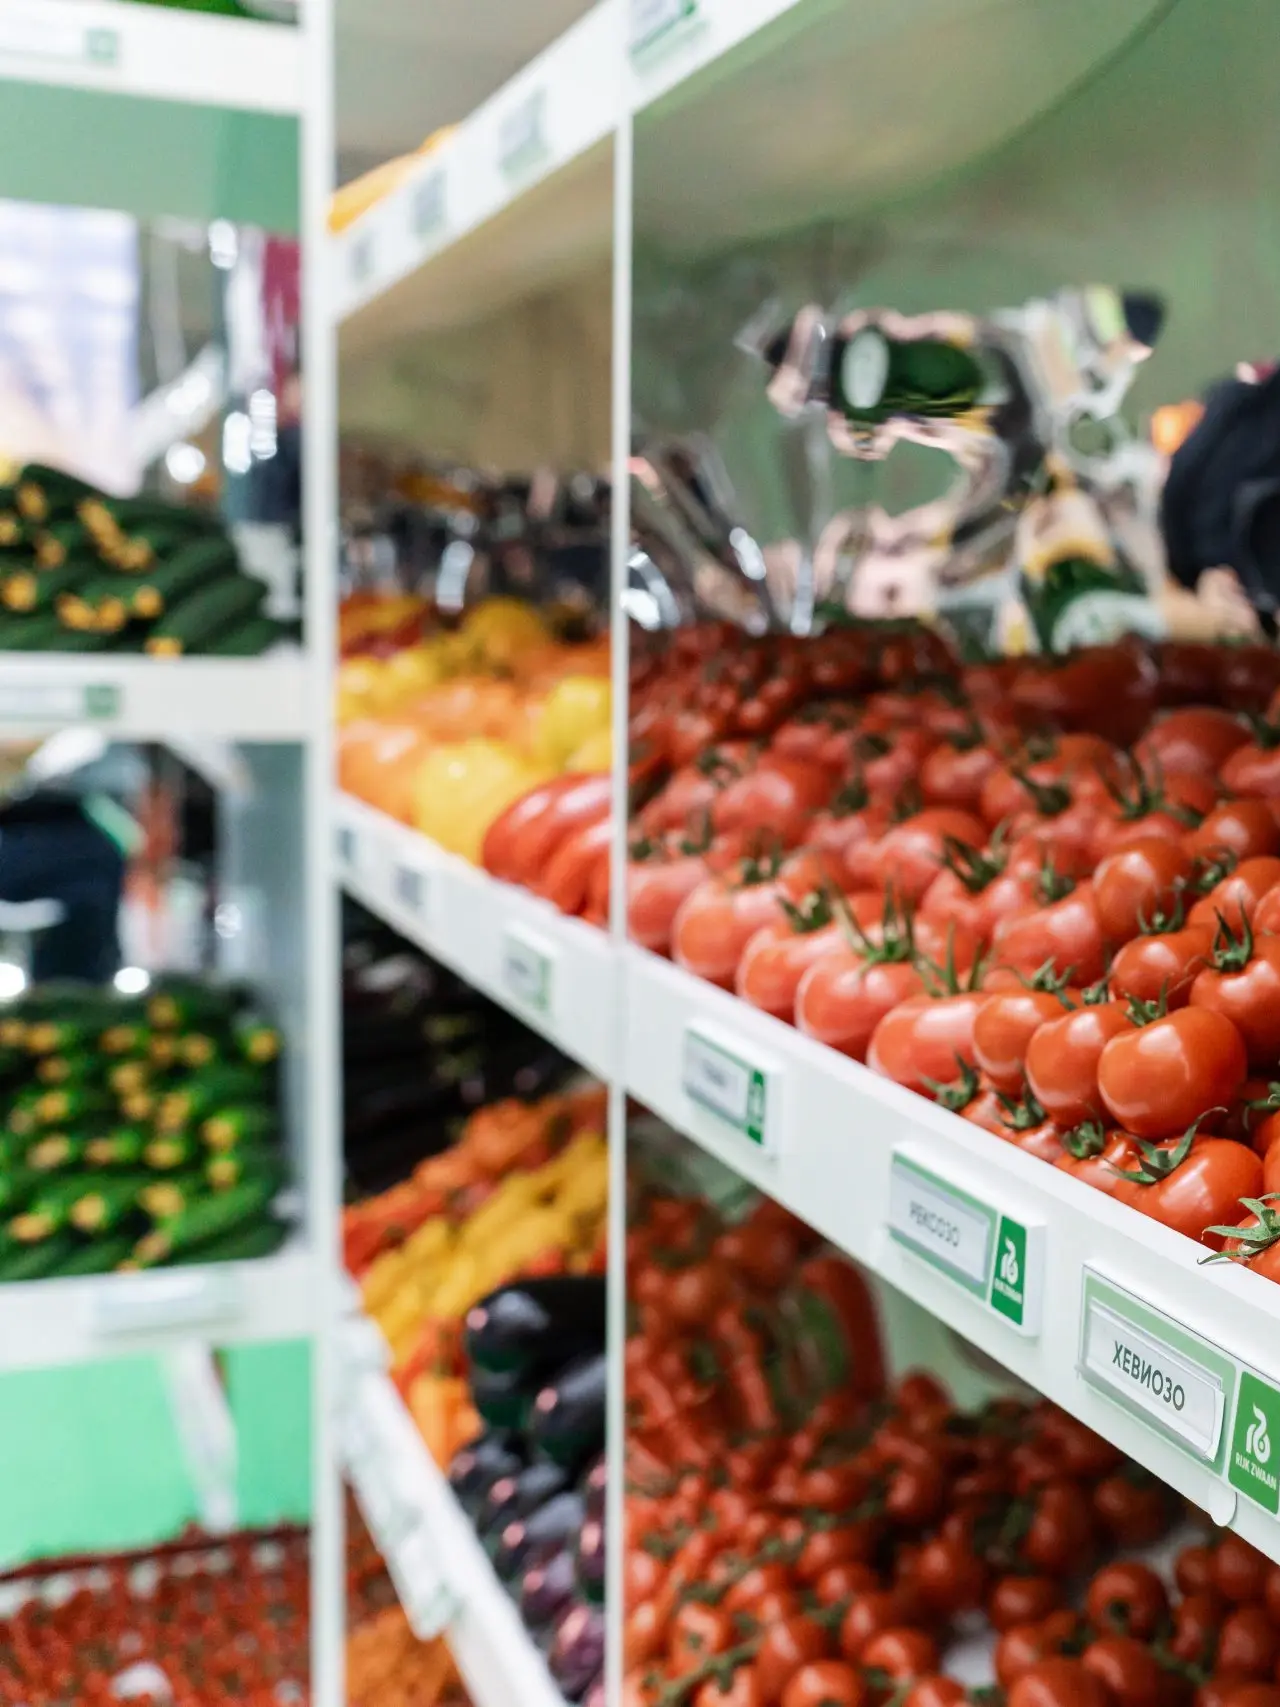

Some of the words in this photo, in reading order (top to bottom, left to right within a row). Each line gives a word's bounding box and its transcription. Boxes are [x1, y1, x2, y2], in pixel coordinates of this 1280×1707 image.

[1112, 1340, 1185, 1411] ХЕВИОЗО
[1235, 1452, 1250, 1473] RIJK
[1250, 1462, 1277, 1490] ZWAAN
